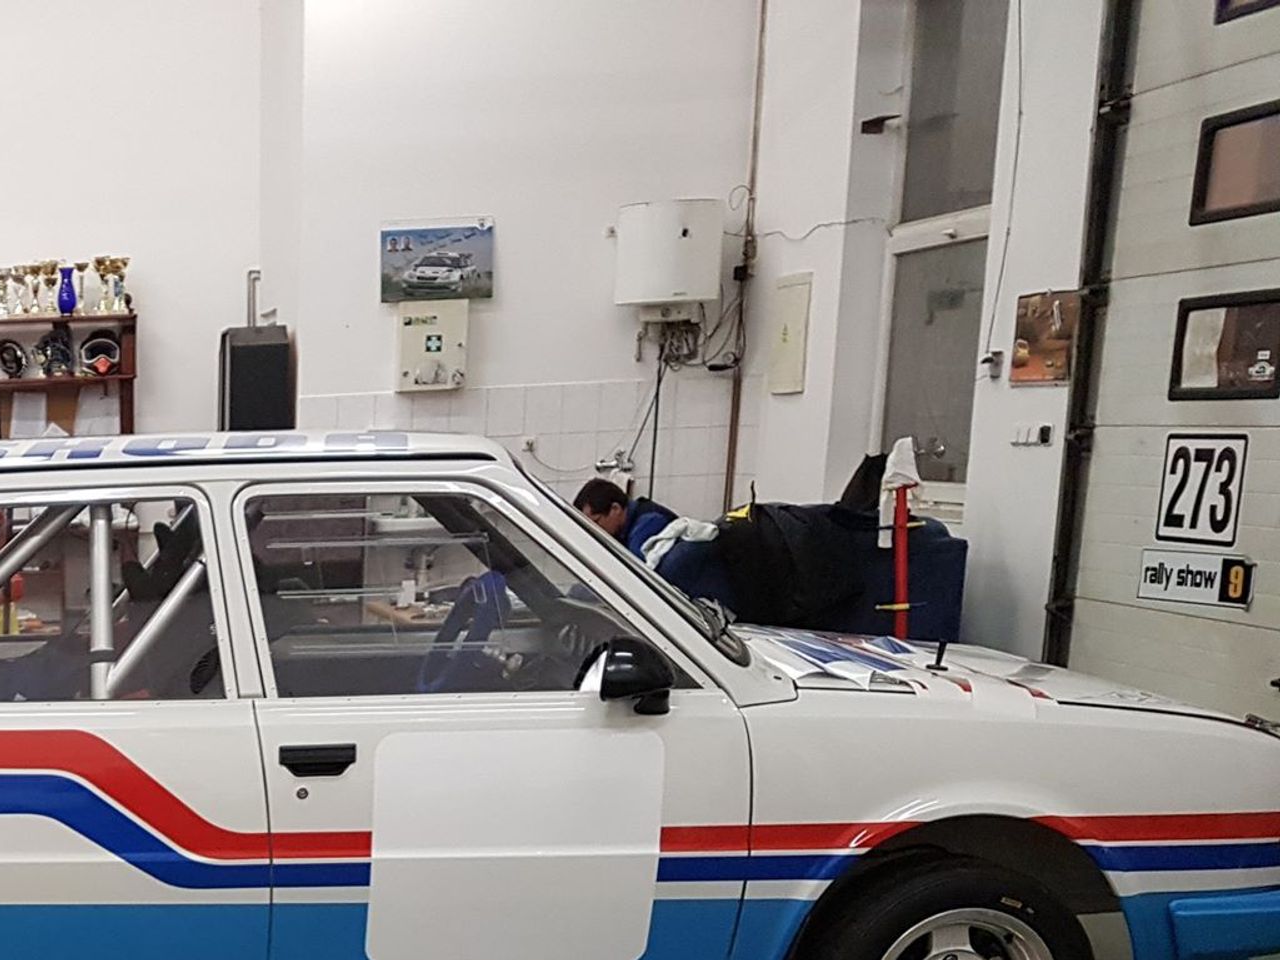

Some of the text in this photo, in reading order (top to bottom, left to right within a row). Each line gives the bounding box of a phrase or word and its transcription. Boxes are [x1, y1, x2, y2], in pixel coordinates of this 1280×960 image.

[1163, 446, 1237, 534] 273
[1144, 562, 1245, 599] rally show 9
